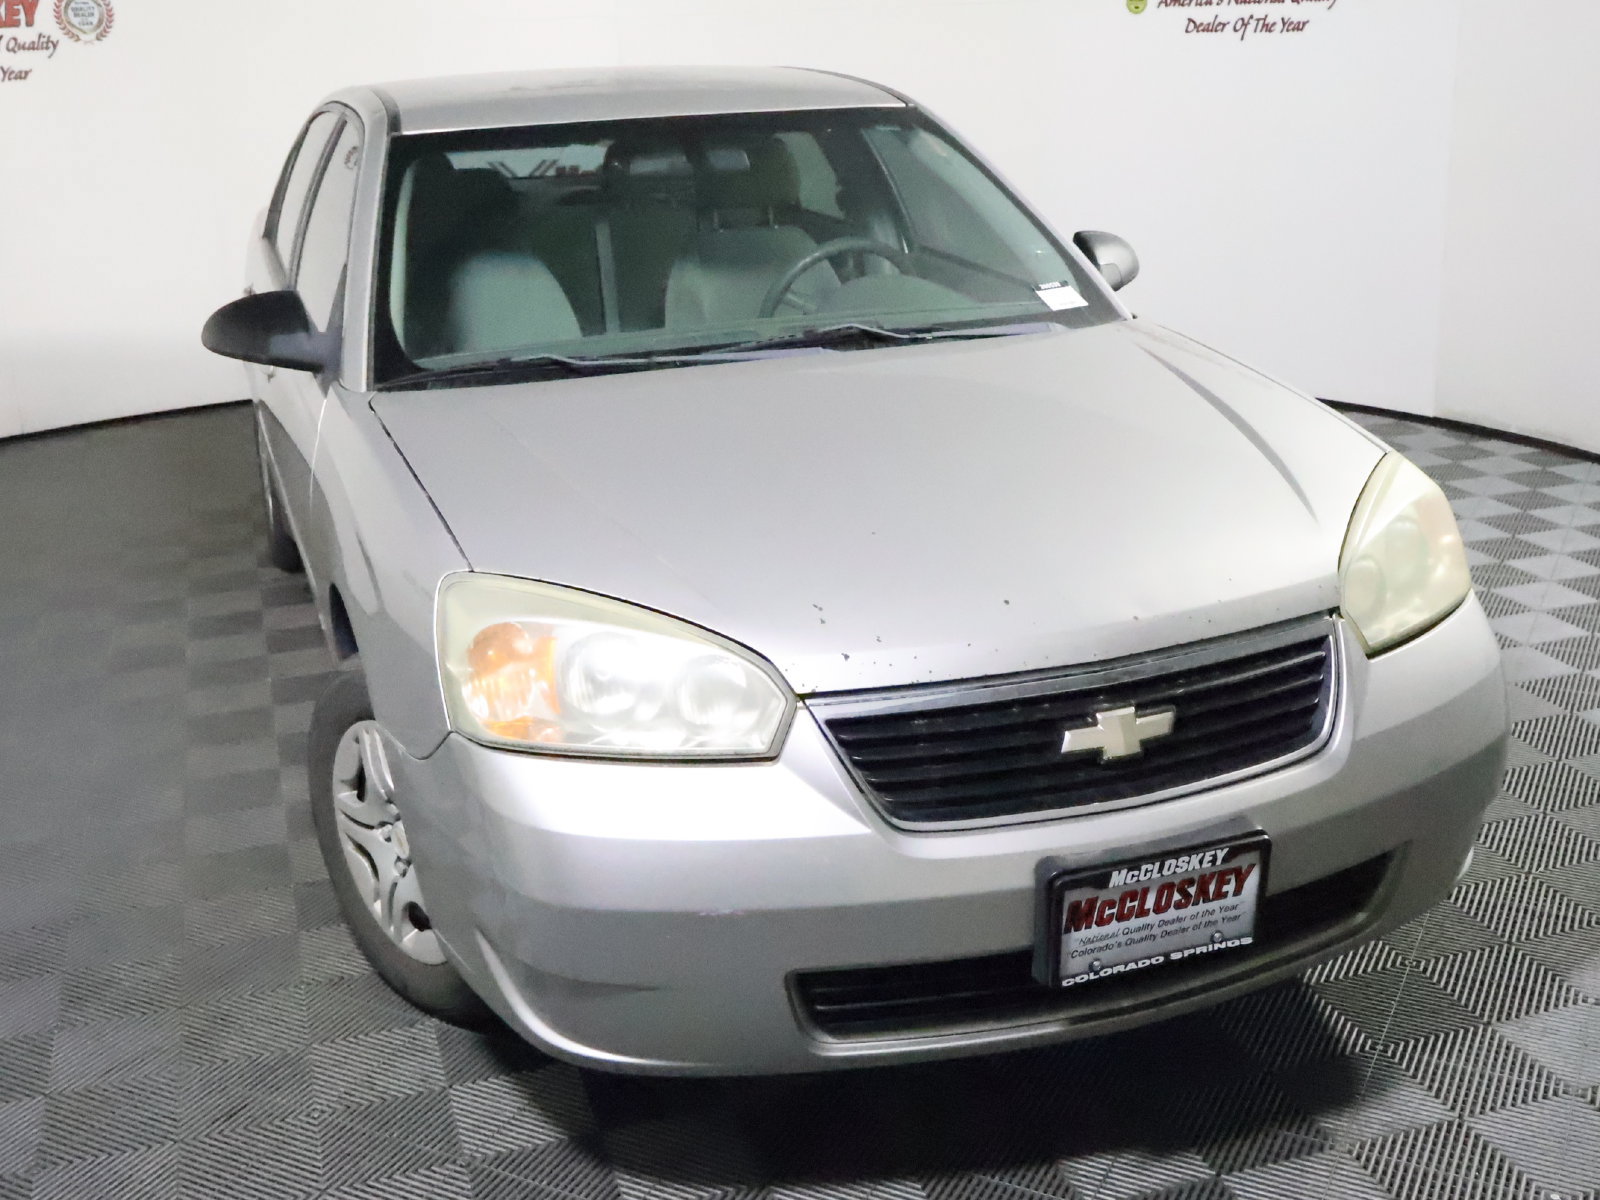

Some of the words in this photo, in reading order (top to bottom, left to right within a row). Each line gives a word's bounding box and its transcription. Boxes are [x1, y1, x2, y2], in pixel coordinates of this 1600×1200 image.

[0, 0, 40, 28] EY
[1185, 14, 1230, 33] Dealer
[1233, 14, 1254, 41] Of
[1254, 14, 1277, 33] The
[1280, 16, 1310, 34] Year
[6, 33, 60, 59] Quality
[0, 66, 33, 82] Year
[1109, 848, 1229, 888] McCLOSKEY
[1063, 864, 1257, 934] McCLOSKEY
[1071, 939, 1122, 959] Colorado's
[1125, 932, 1158, 946] Quality
[1160, 926, 1191, 939] Dealer
[1192, 922, 1202, 931] of
[1204, 919, 1219, 928] the
[1222, 914, 1242, 923] Year
[1079, 929, 1120, 946] National
[1122, 919, 1156, 935] Quality
[1157, 915, 1186, 928] Dealer
[1190, 911, 1199, 920] of
[1201, 908, 1216, 918] the
[1219, 903, 1239, 914] Year
[1062, 955, 1164, 987] COLORADO
[1170, 937, 1253, 960] SPRINGS
